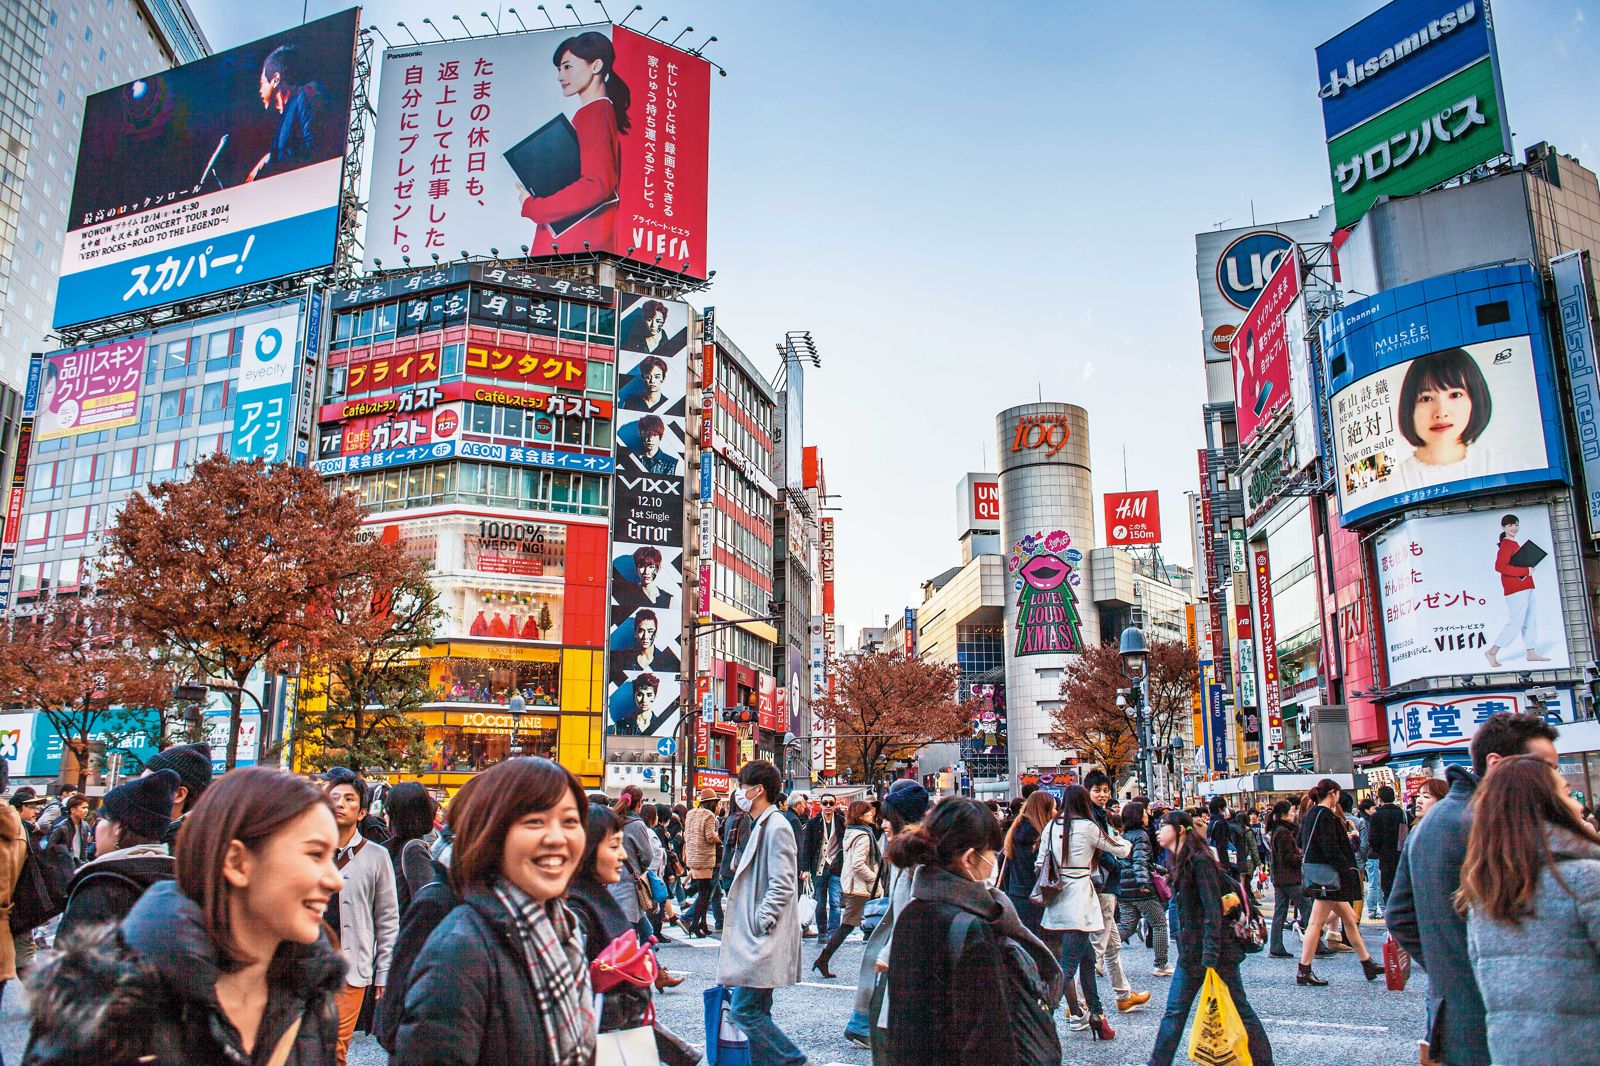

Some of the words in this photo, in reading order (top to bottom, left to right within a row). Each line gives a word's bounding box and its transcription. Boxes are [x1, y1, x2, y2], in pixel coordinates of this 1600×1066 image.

[387, 50, 423, 60] Panasonic
[1317, 1, 1476, 99] Hisamitsu
[466, 57, 494, 207] たまの休日も、
[643, 55, 659, 209] 家じゅう持ち運べるテレビ。
[663, 62, 678, 217] 忙しいひとは、録画もできる
[1333, 94, 1486, 194] サロンパス
[392, 65, 423, 253] 自分にプレゼント。
[424, 60, 460, 248] 返上して仕事した
[83, 184, 203, 225] 最高のロックンロール
[81, 224, 112, 240] WOWOW
[140, 211, 161, 225] 12/14
[143, 217, 181, 235] CONCERT
[185, 210, 208, 223] TOUR
[210, 204, 230, 216] 2014
[156, 231, 167, 241] TO
[169, 226, 185, 238] THE
[122, 234, 255, 301] スカパー!
[403, 271, 447, 290] 月の宴
[484, 269, 537, 289] 月の宴
[344, 286, 384, 304] 月の宴
[549, 280, 601, 300] 月の宴
[407, 295, 464, 321] 月の宴
[481, 296, 553, 324] 月の宴
[1346, 304, 1380, 326] Channel
[1375, 334, 1430, 357] PLATINUM
[1561, 285, 1594, 380] Taisei
[60, 346, 142, 381] 品川スキン
[245, 363, 287, 382] eyecity
[350, 352, 438, 388] プライス
[467, 348, 582, 382] コンタクト
[57, 367, 139, 403] クリニック
[397, 387, 444, 413] ガスト
[546, 394, 600, 418] ガスト
[1339, 412, 1354, 424] NEW
[1356, 394, 1390, 415] SINGLE
[346, 429, 370, 444] Café
[371, 420, 427, 451] ガスト
[437, 421, 457, 431] ガスト
[1340, 406, 1394, 452] 「絶対」
[1573, 385, 1600, 462] neon
[321, 433, 342, 452] 7F
[345, 442, 369, 452] レストラン
[1008, 420, 1071, 457] 109
[1343, 452, 1360, 465] Now
[1360, 445, 1372, 456] on
[1374, 437, 1395, 450] sale
[314, 460, 342, 473] AEON
[349, 447, 429, 470] 英会話イーオン
[435, 445, 448, 455] 6F
[462, 443, 502, 458] AEON
[510, 447, 611, 470] 英会話イーオン
[619, 474, 681, 496] VIXX
[630, 508, 644, 519] 1st
[645, 510, 670, 522] Single
[637, 495, 663, 508] 12.10
[1115, 497, 1148, 520] H&M
[480, 521, 544, 543] 1000%
[1129, 530, 1154, 539] 150m
[479, 538, 544, 554] WEDDING!
[1030, 592, 1064, 605] LOVE!
[1386, 590, 1486, 623] 自分にプレゼント。
[1027, 605, 1069, 624] LOUD!
[1259, 575, 1274, 672] ウィンターフルーツギフト
[1021, 624, 1077, 652] XMAS!
[1213, 691, 1221, 718] MIZUHO
